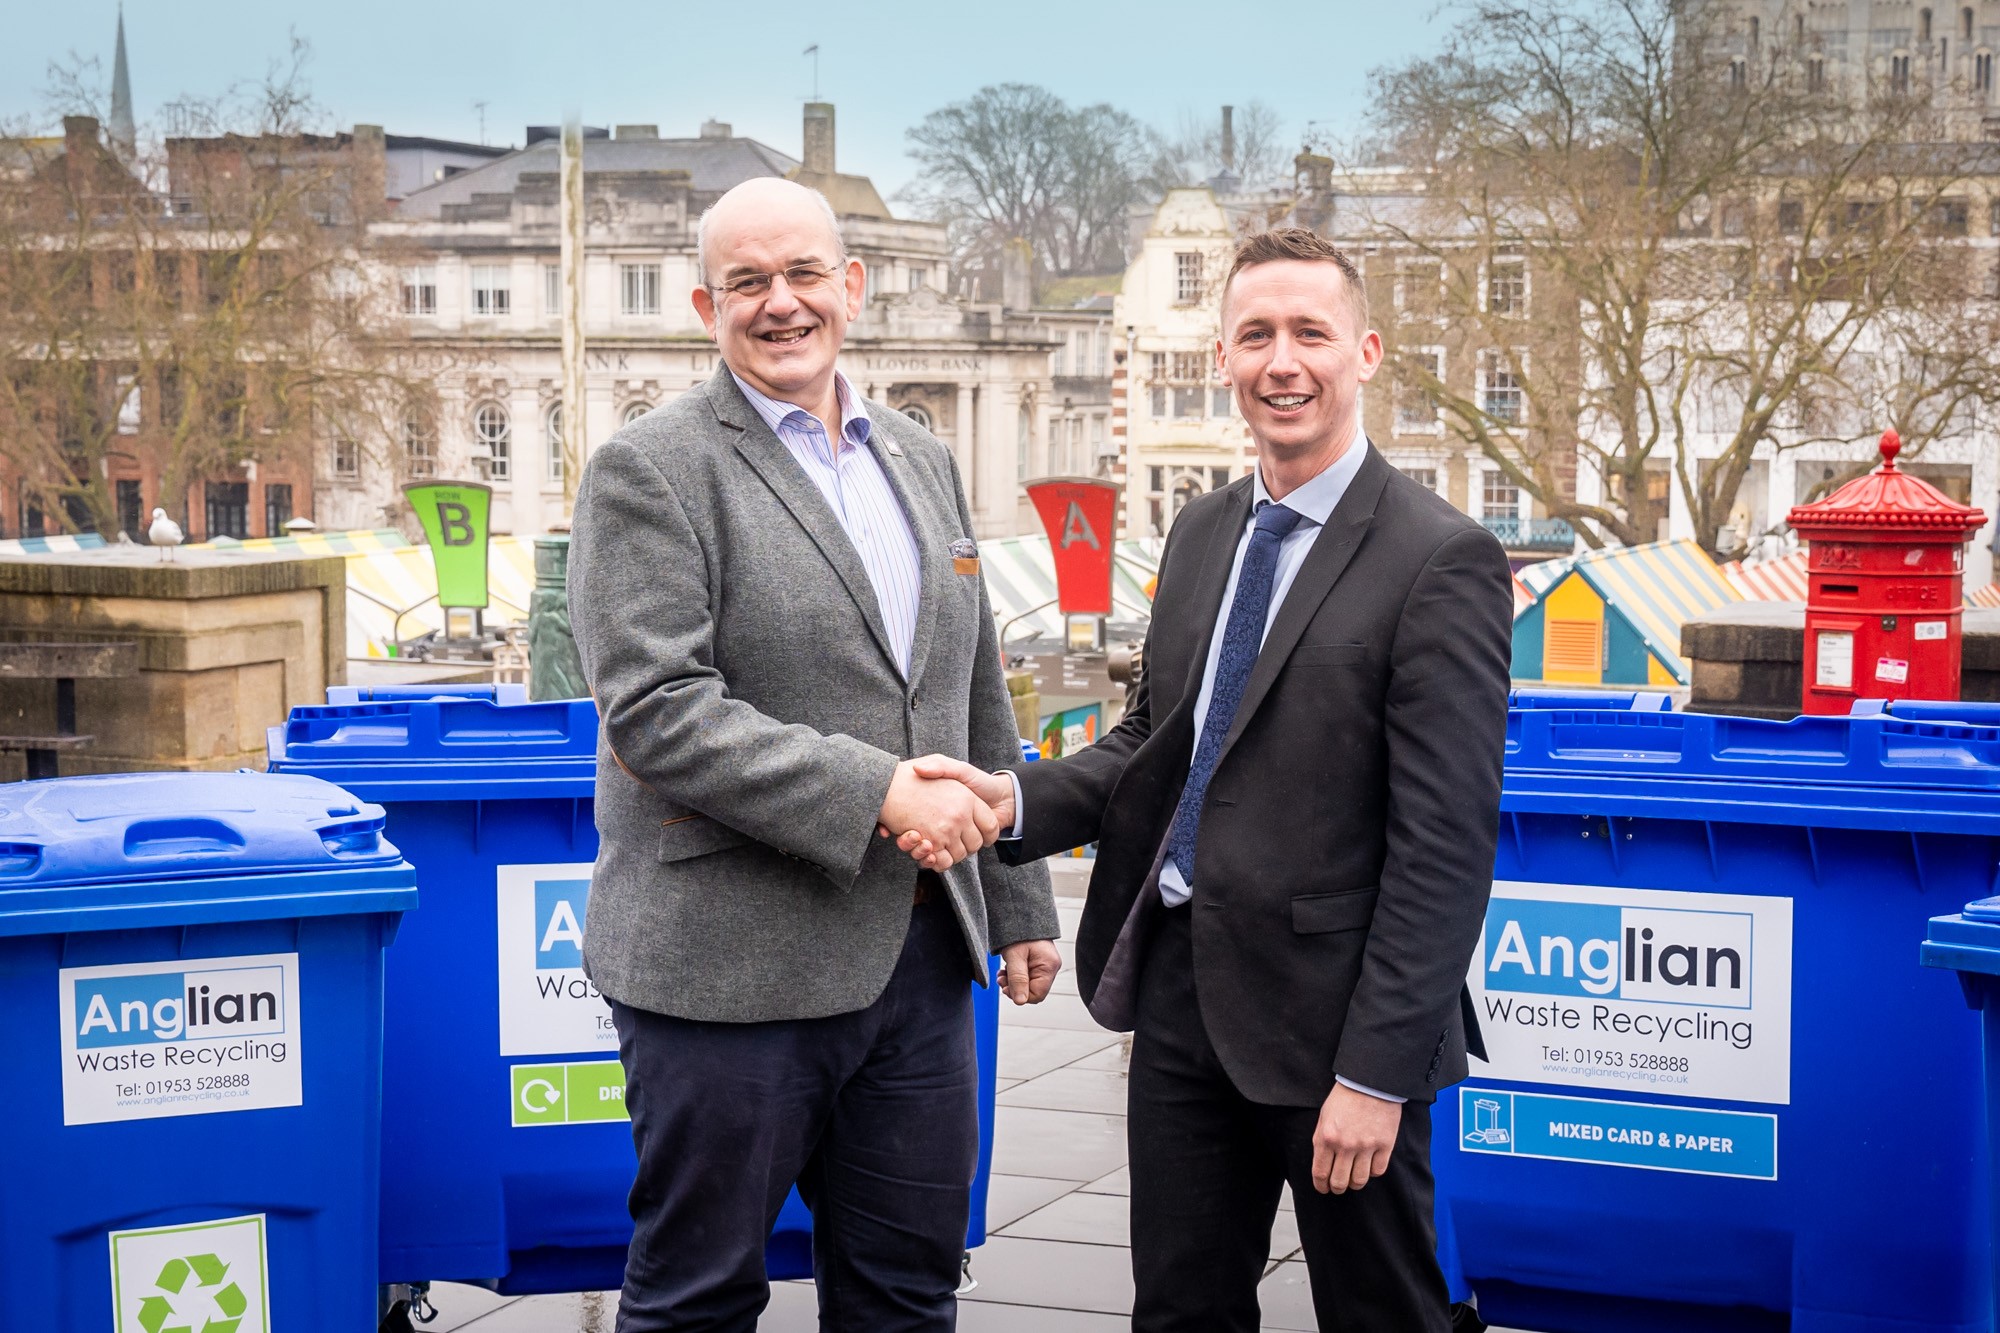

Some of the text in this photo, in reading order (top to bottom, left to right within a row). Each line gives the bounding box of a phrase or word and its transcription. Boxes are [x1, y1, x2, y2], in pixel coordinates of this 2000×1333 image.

[436, 502, 475, 546] B
[1060, 501, 1100, 550] A
[1489, 919, 1741, 995] Anglian
[536, 975, 601, 1000] Was
[79, 984, 277, 1040] Anglian
[1485, 996, 1752, 1049] Waste Recycling
[77, 1040, 286, 1073] Waste Recycling
[1542, 1045, 1689, 1073] Tel: 01953 528888
[115, 1073, 250, 1097] Tel: 01953 528888
[1542, 1063, 1689, 1085] www.anglianrecycling.co.uk
[116, 1088, 250, 1107] www.anglianrecycling.co.uk
[599, 1085, 627, 1101] DR
[1550, 1121, 1734, 1153] MIXED CARD & PAPER
